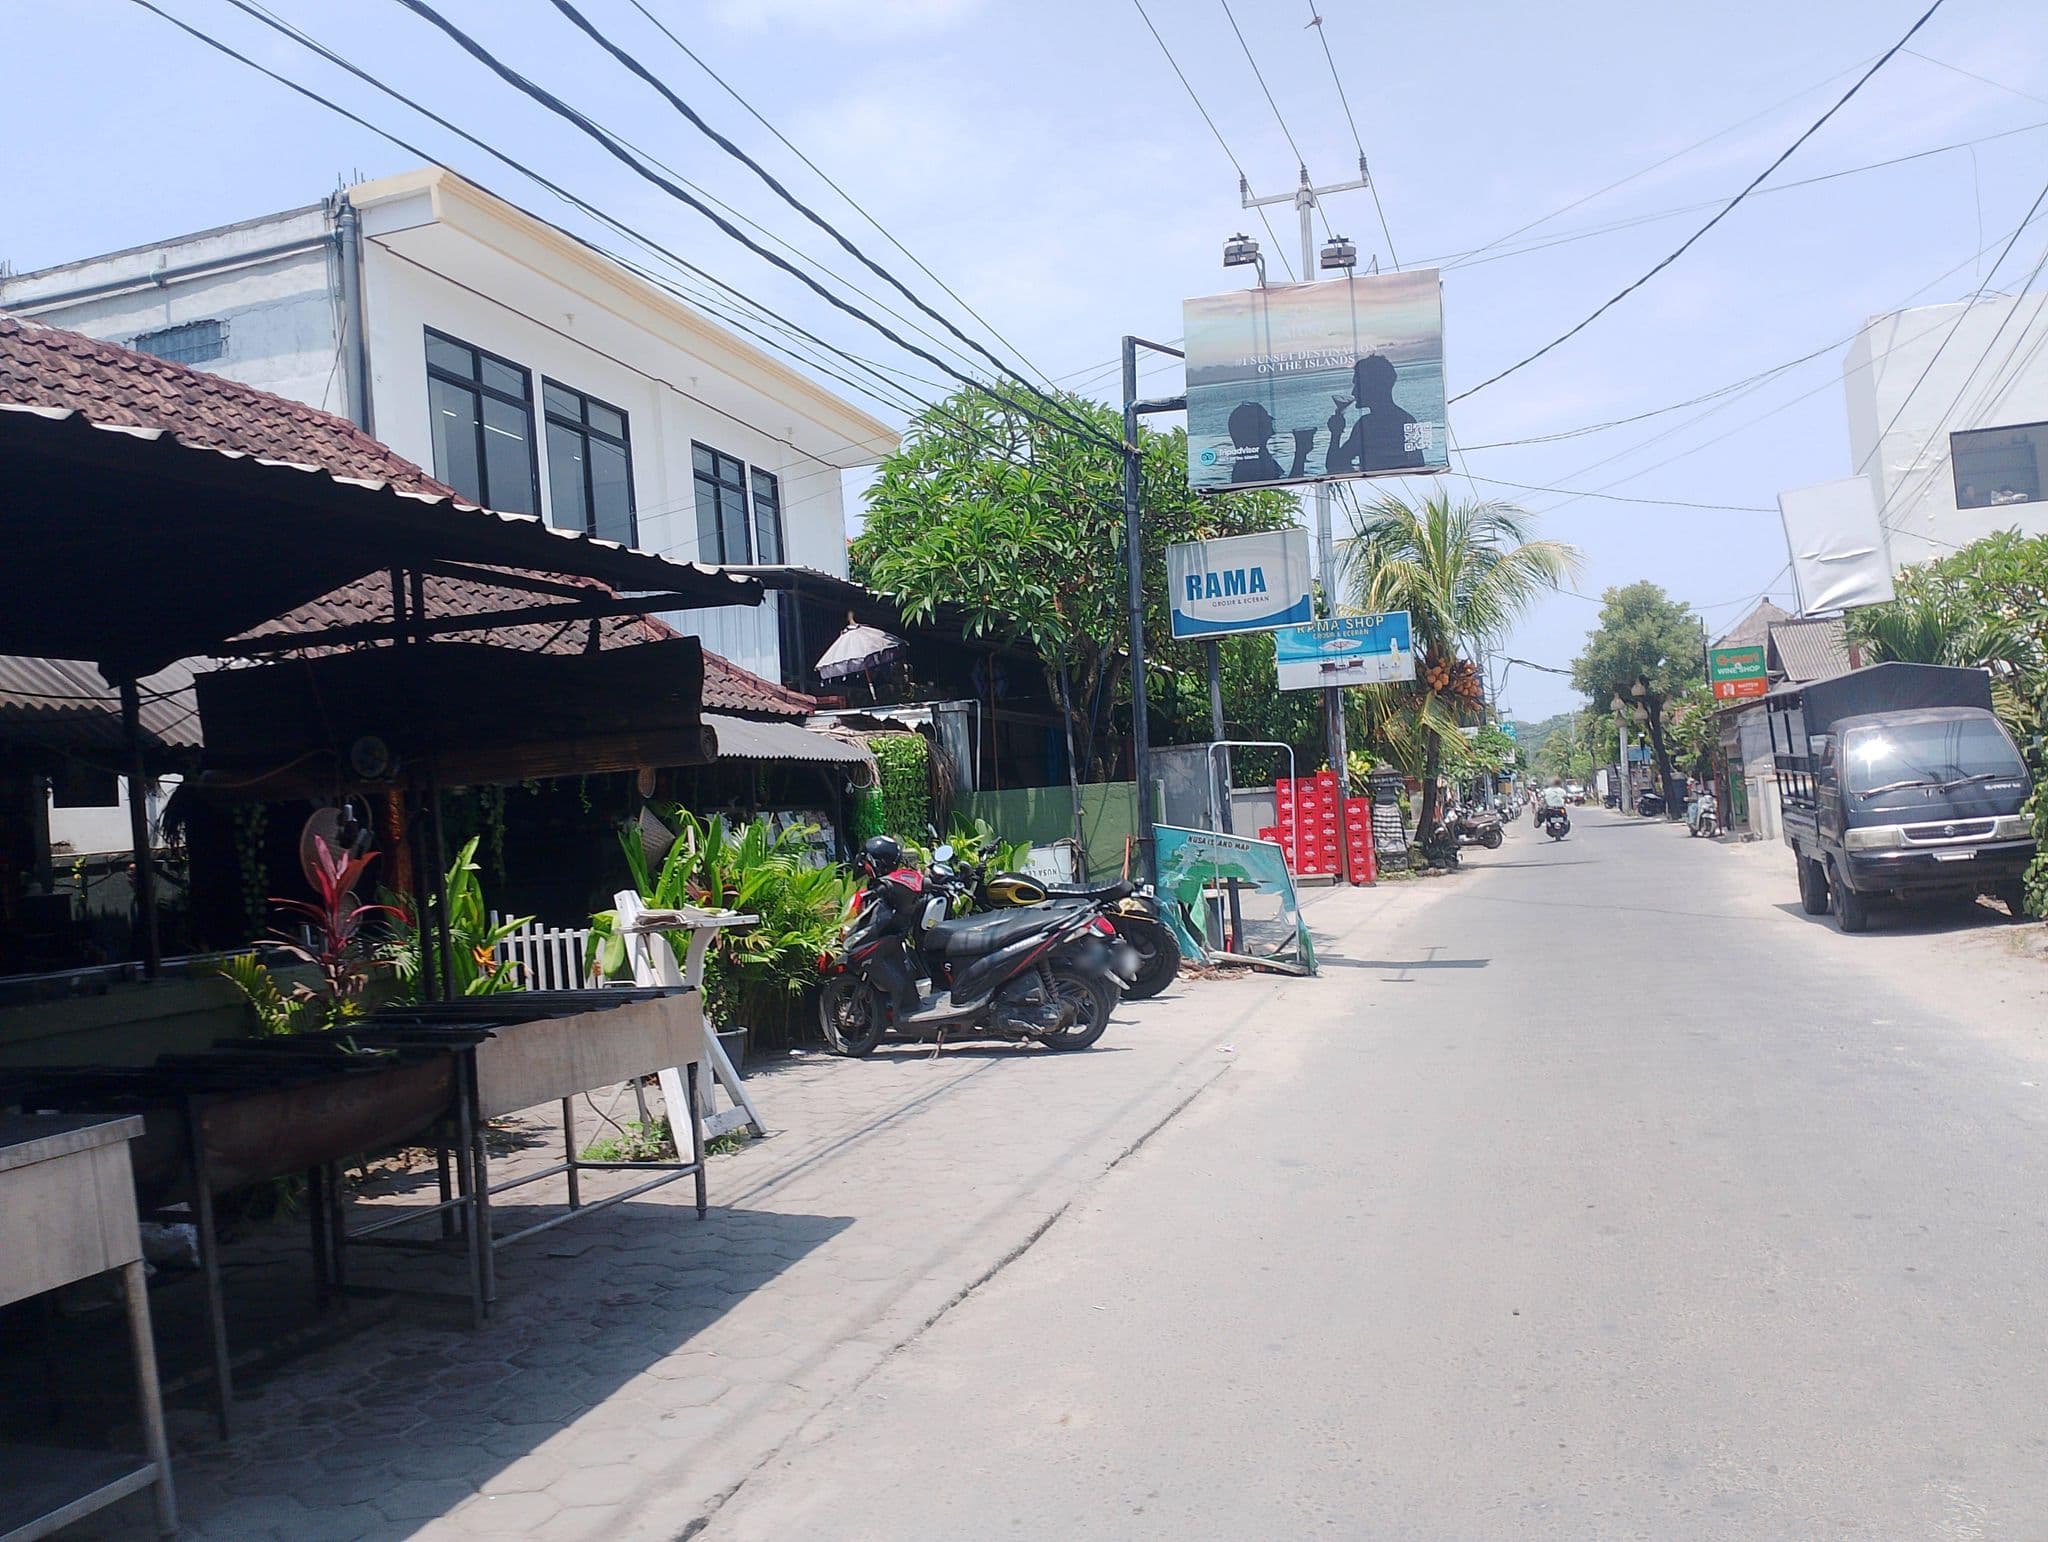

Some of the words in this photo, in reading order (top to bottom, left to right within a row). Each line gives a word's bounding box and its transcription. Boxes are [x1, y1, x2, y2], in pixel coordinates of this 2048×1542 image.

[1250, 351, 1294, 365] SUNSET
[1298, 344, 1377, 360] DESTINATON
[1257, 363, 1274, 374] ON
[1278, 360, 1302, 371] THE
[1305, 354, 1355, 369] ISLANDS
[1185, 567, 1266, 601] RAMA
[1346, 615, 1384, 630] SHOP
[1188, 835, 1206, 845] NUSA
[1207, 839, 1233, 848] ISAND
[1235, 843, 1251, 851] MAP
